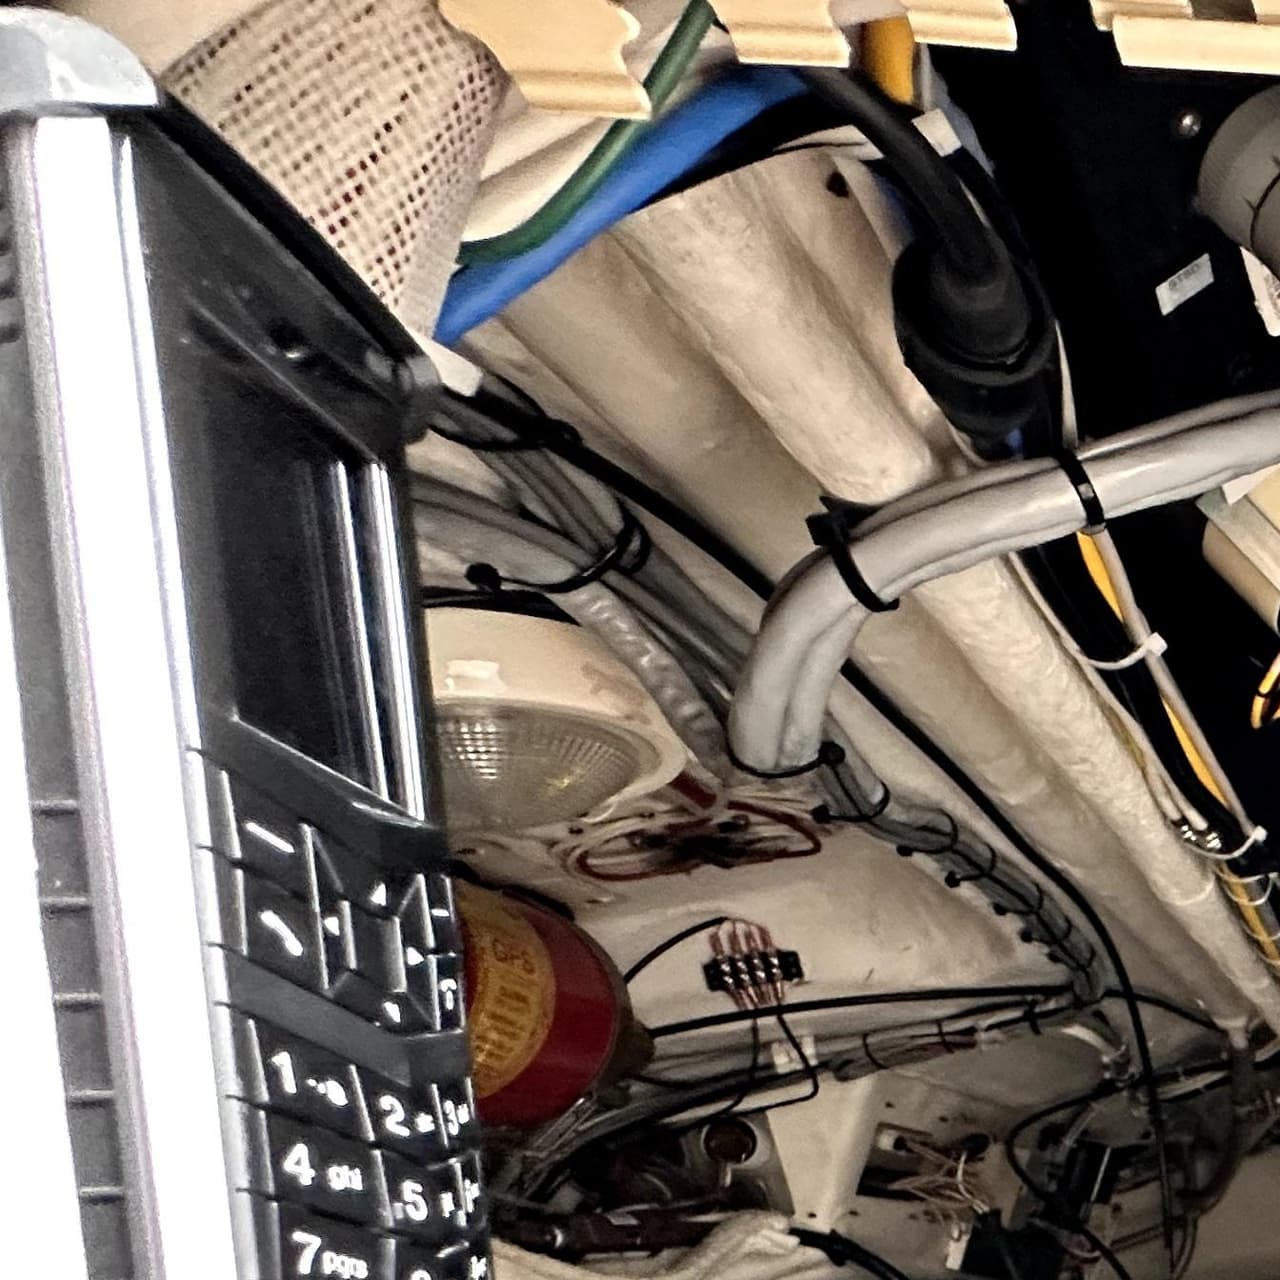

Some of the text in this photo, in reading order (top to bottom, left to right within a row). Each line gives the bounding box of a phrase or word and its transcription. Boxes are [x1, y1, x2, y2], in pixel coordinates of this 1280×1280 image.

[271, 1051, 297, 1094] 1
[379, 1095, 410, 1137] 2
[282, 1143, 316, 1185] 4
[401, 1179, 428, 1221] 5
[292, 1230, 322, 1275] 7
